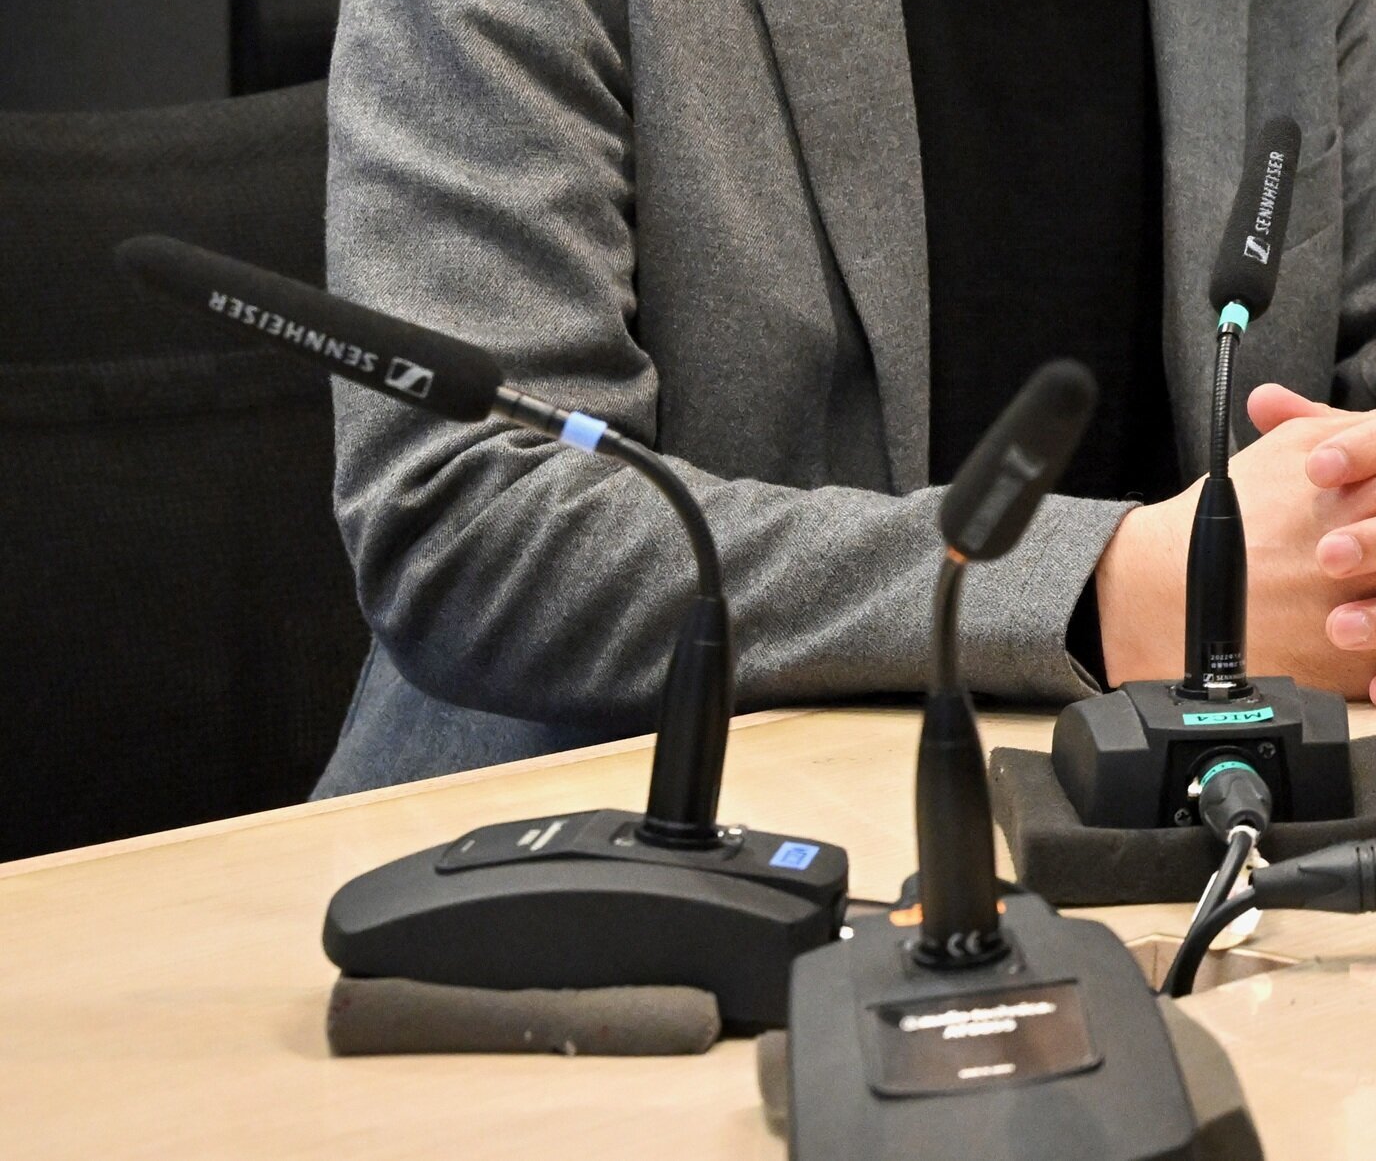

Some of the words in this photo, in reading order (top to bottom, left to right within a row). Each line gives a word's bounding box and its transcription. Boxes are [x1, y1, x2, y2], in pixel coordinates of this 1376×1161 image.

[1255, 151, 1285, 235] SENNHEISER
[208, 289, 380, 372] SENNHEISER
[1197, 712, 1262, 722] MIC4
